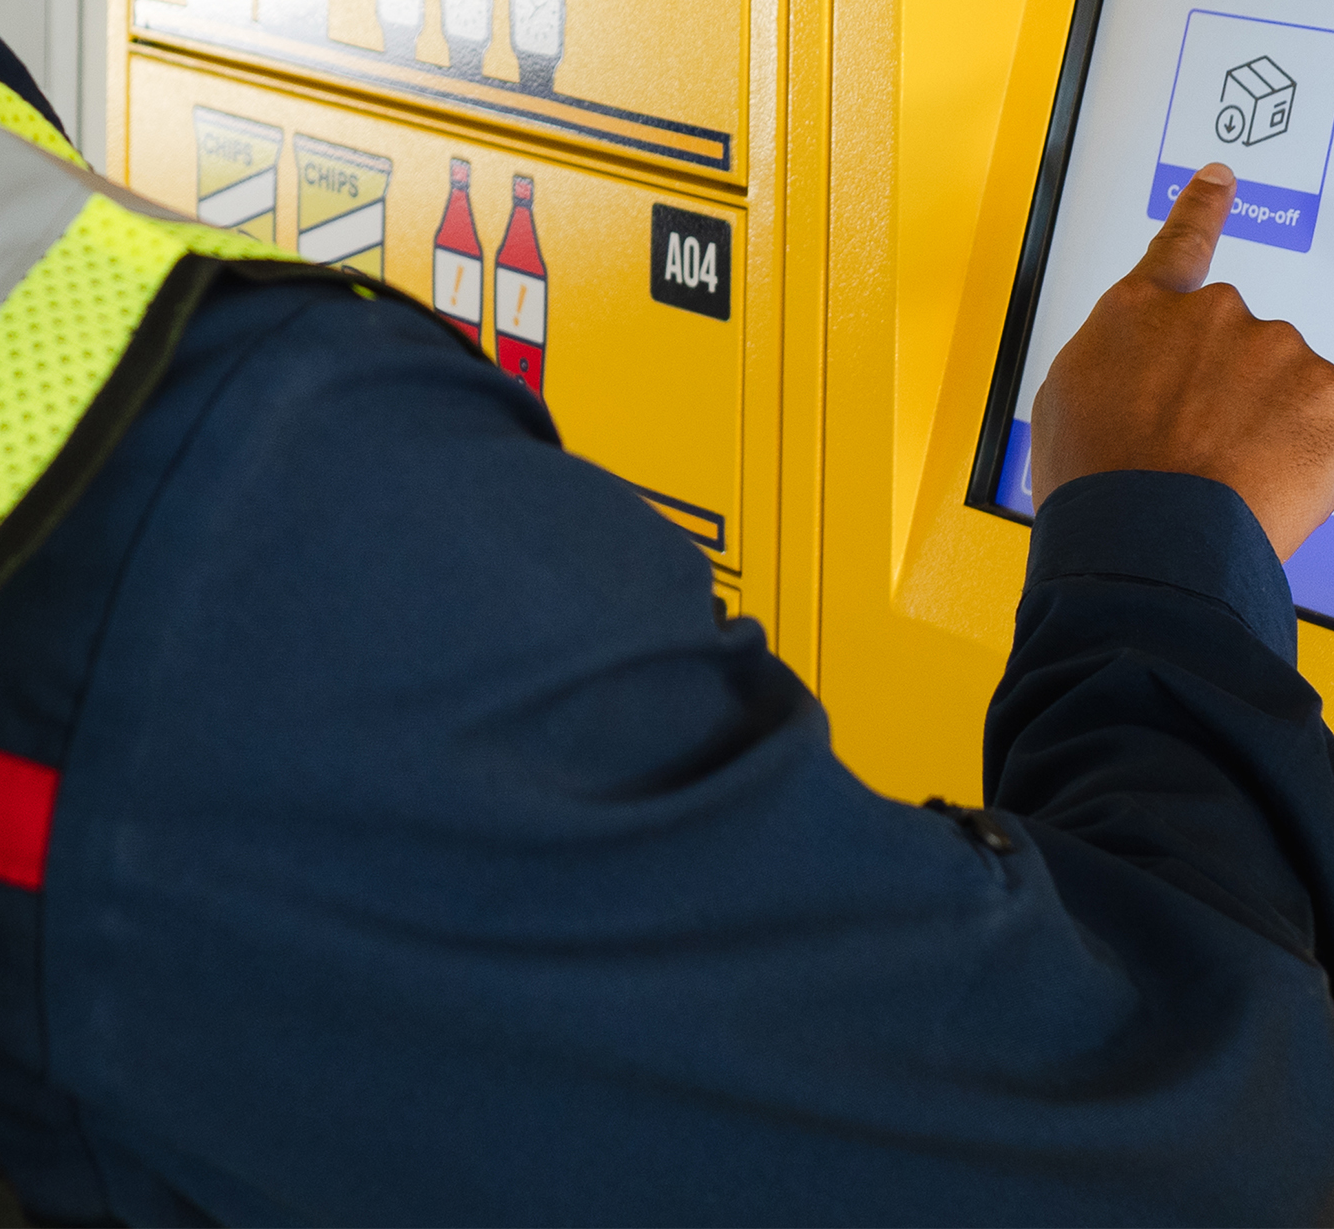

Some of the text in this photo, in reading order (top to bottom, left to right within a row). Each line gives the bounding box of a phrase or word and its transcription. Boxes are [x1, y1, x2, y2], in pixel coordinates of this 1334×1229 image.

[201, 131, 253, 167] CHIPS
[304, 162, 359, 198] CHIPS
[1231, 197, 1301, 227] Drop-off
[664, 231, 719, 294] A04
